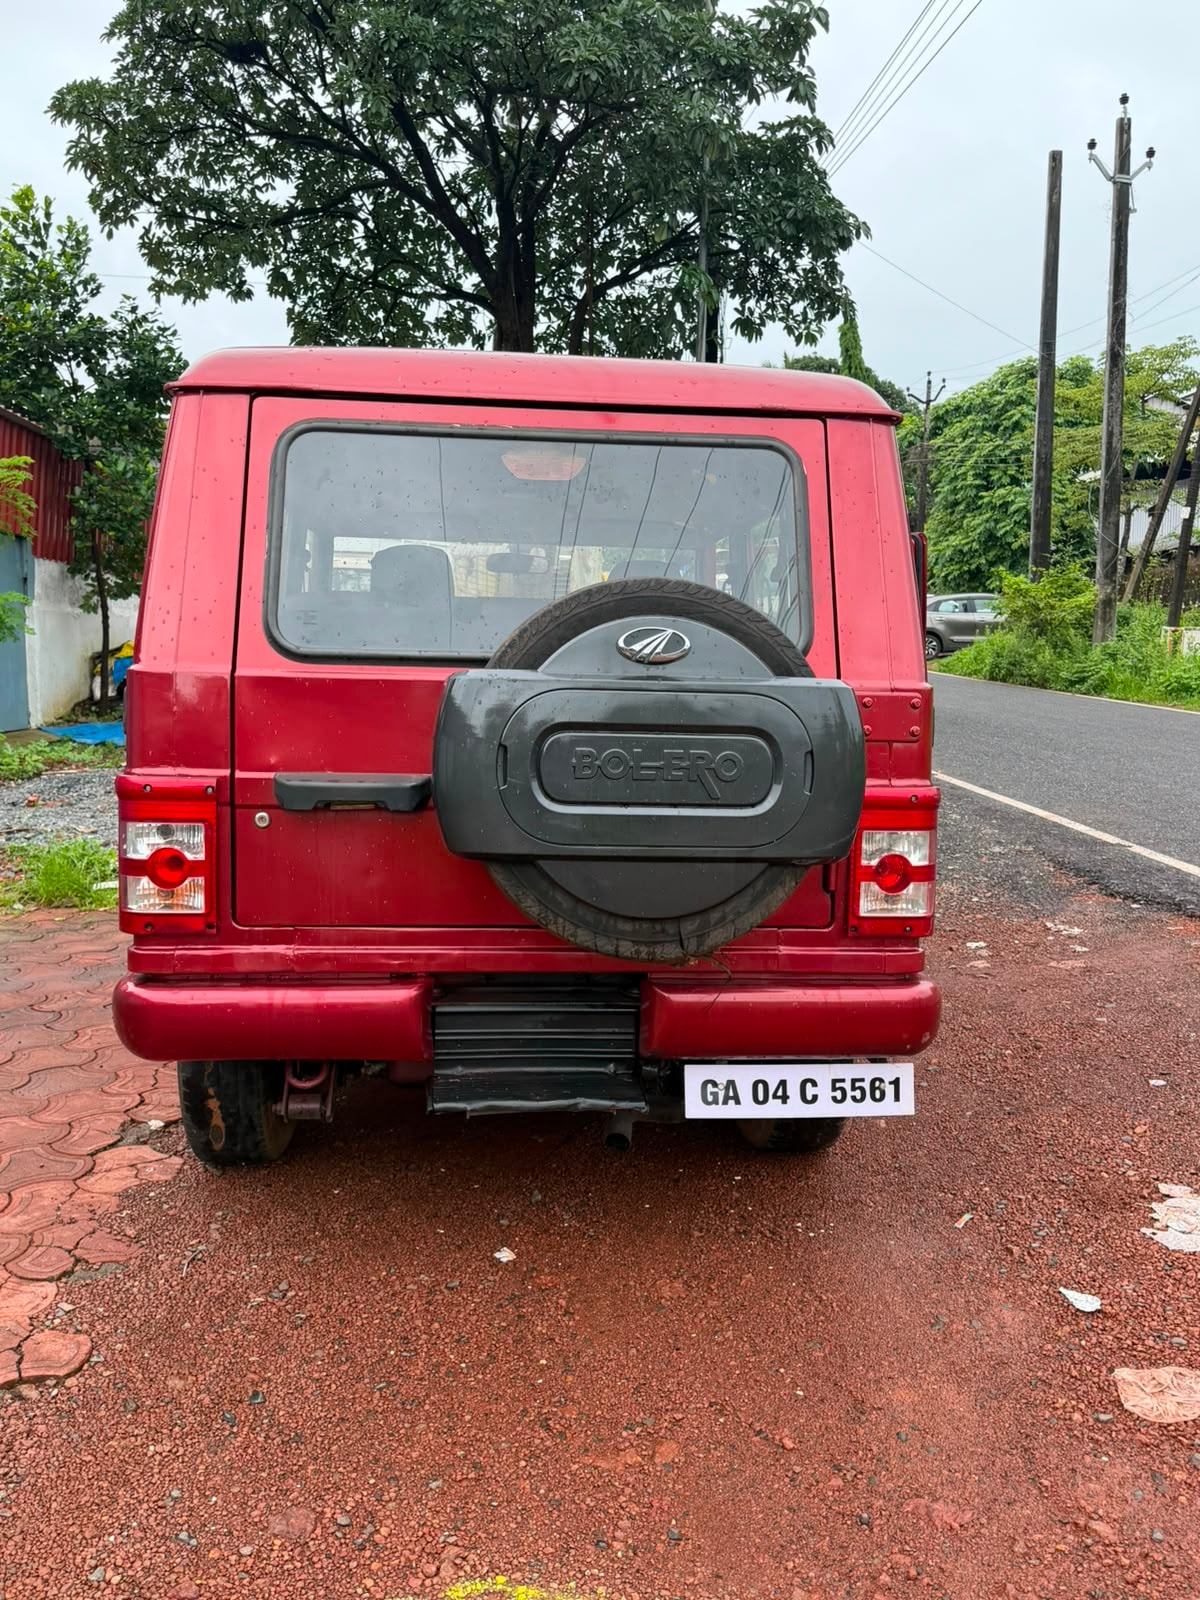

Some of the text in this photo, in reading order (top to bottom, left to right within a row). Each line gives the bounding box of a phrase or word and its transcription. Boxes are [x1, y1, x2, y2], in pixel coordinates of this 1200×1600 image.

[572, 747, 744, 799] BOLERO
[700, 1076, 901, 1106] GA 04 C 5561
